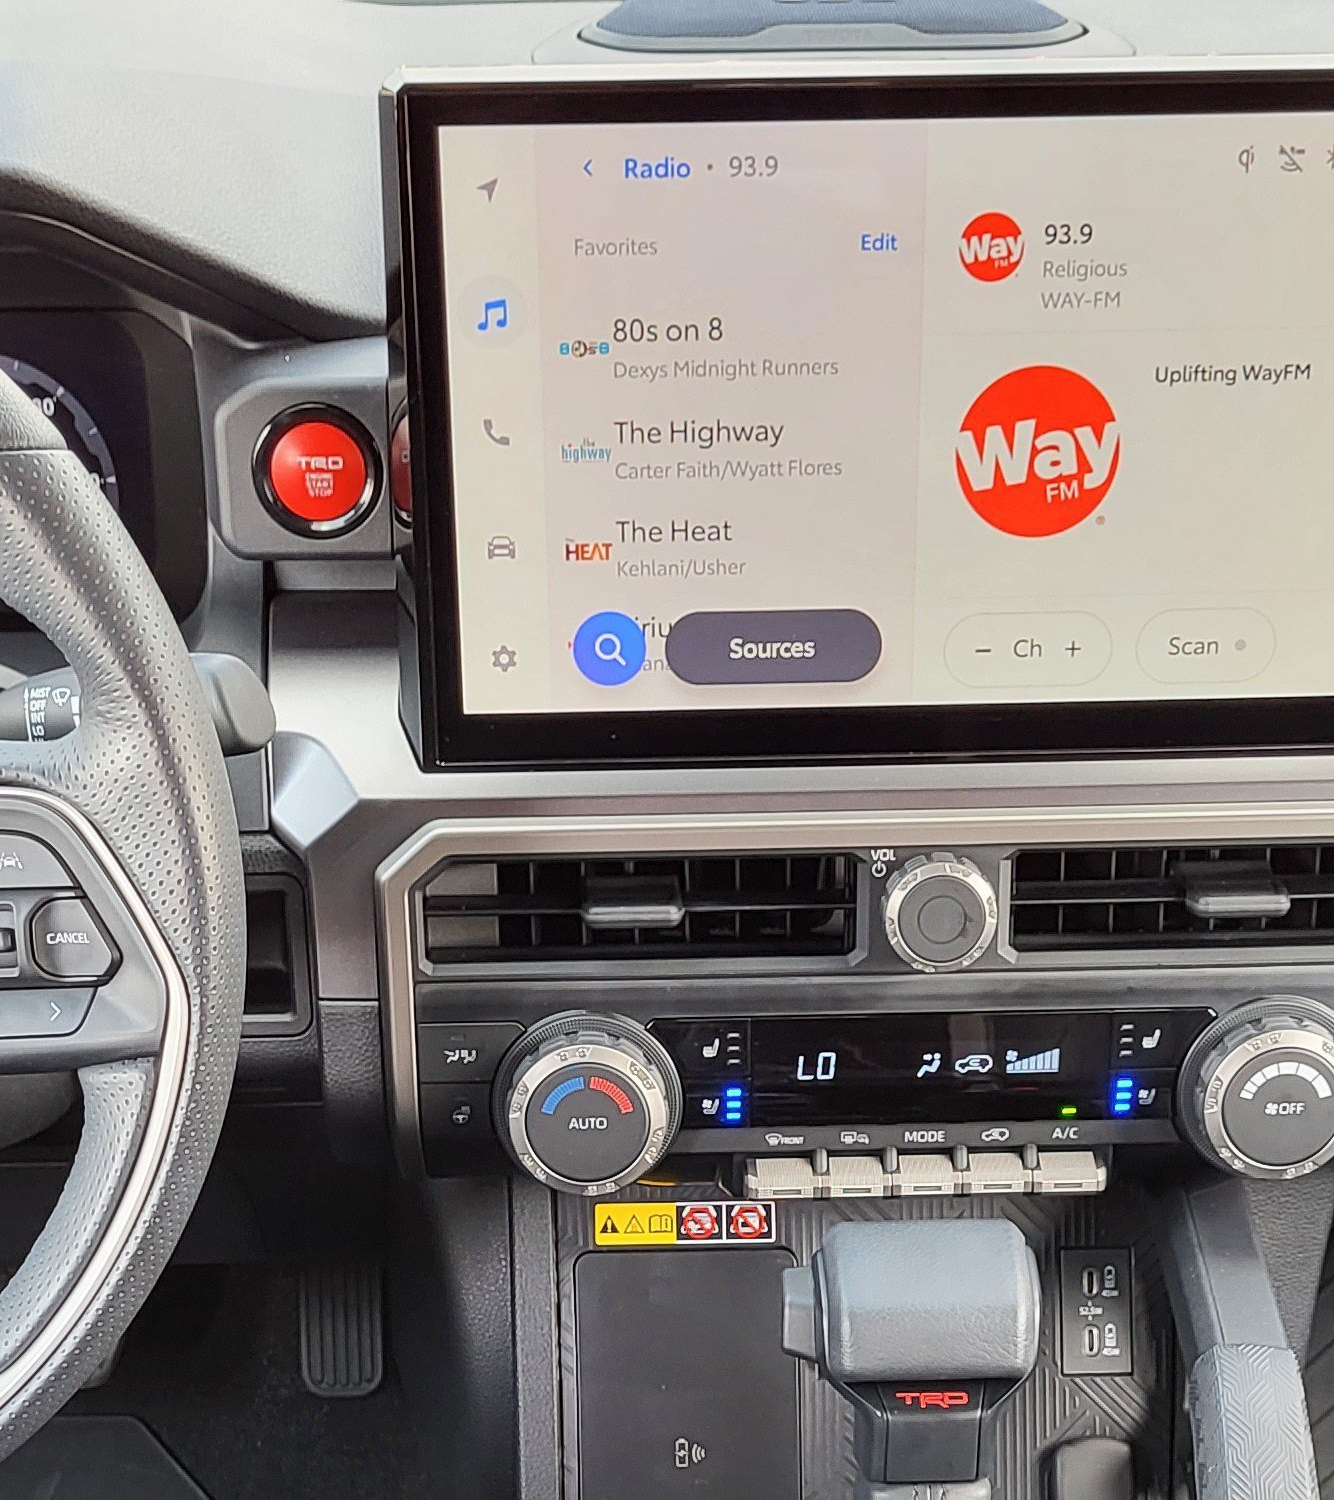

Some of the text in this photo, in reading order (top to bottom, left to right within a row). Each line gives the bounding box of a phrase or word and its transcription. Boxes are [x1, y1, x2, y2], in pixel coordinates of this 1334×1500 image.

[623, 157, 692, 179] Radio
[728, 156, 779, 178] 93.9
[860, 233, 899, 252] Edit
[1044, 223, 1093, 245] 93.9
[573, 237, 659, 258] Favorites
[959, 233, 1024, 265] Way
[1042, 259, 1128, 282] Religious
[1040, 291, 1121, 309] WAY-FM
[613, 317, 724, 342] 80s on 8
[613, 358, 839, 381] Dexys Midnight Runners
[1155, 364, 1312, 387] Uplifting WayFM
[614, 421, 785, 449] The Highway
[296, 455, 344, 470] TRD
[561, 444, 612, 463] highway
[957, 418, 1120, 492] Way
[614, 459, 843, 481] Carter Faith/Wyatt Flores
[1046, 479, 1079, 502] FM
[615, 519, 733, 543] The Heat
[565, 543, 613, 562] HEAT
[616, 558, 747, 579] Kehlani/Usher
[728, 638, 816, 660] Sources
[1012, 639, 1043, 660] Ch
[1168, 637, 1220, 657] Scan
[29, 700, 47, 711] OFF
[870, 849, 897, 861] VOL
[46, 931, 91, 945] CANCEL
[1278, 1102, 1306, 1116] OFF
[568, 1116, 608, 1131] AUTO
[1051, 1126, 1079, 1140] A/C
[903, 1130, 947, 1144] MODE
[894, 1391, 969, 1409] TRD
